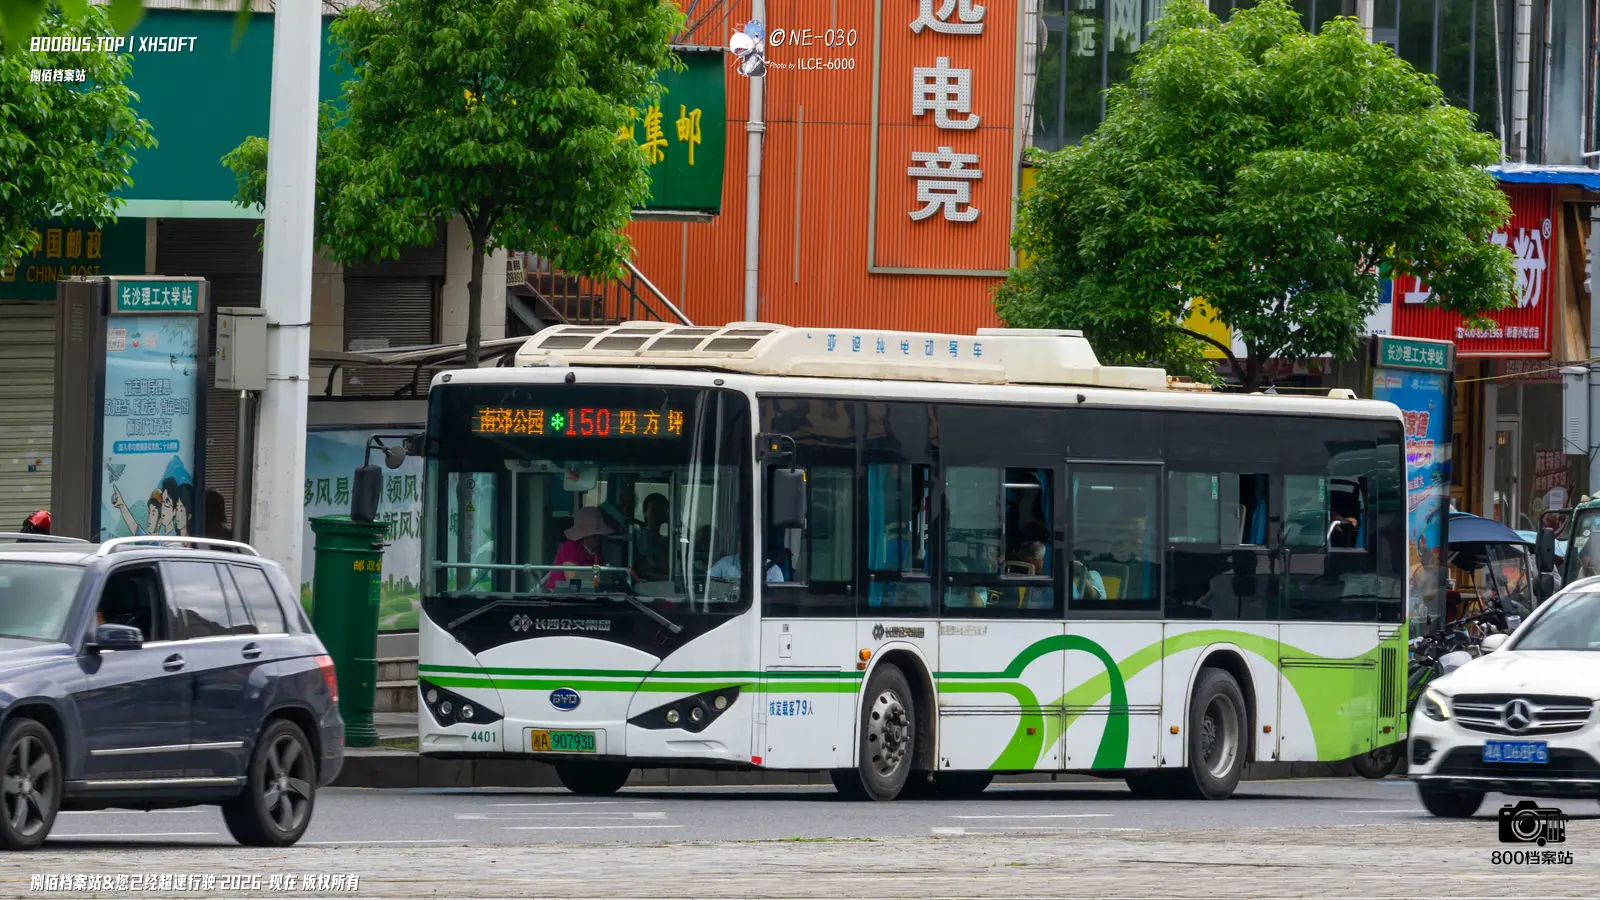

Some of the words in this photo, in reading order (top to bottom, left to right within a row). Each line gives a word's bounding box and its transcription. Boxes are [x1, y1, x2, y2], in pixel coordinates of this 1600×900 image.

[31, 228, 101, 258] 中国邮政
[27, 265, 64, 283] CHINA
[122, 287, 192, 306] 长沙理工大学站
[1387, 344, 1444, 366] 长沙理工大学站
[479, 407, 544, 435] 南郊公园
[566, 408, 611, 436] 150
[619, 409, 684, 435] 四方坪
[535, 618, 611, 631] 长沙公交集团
[552, 694, 578, 704] BYD
[769, 699, 814, 716] 核定载客79人
[471, 731, 497, 743] 4401
[552, 733, 595, 750] 90793D
